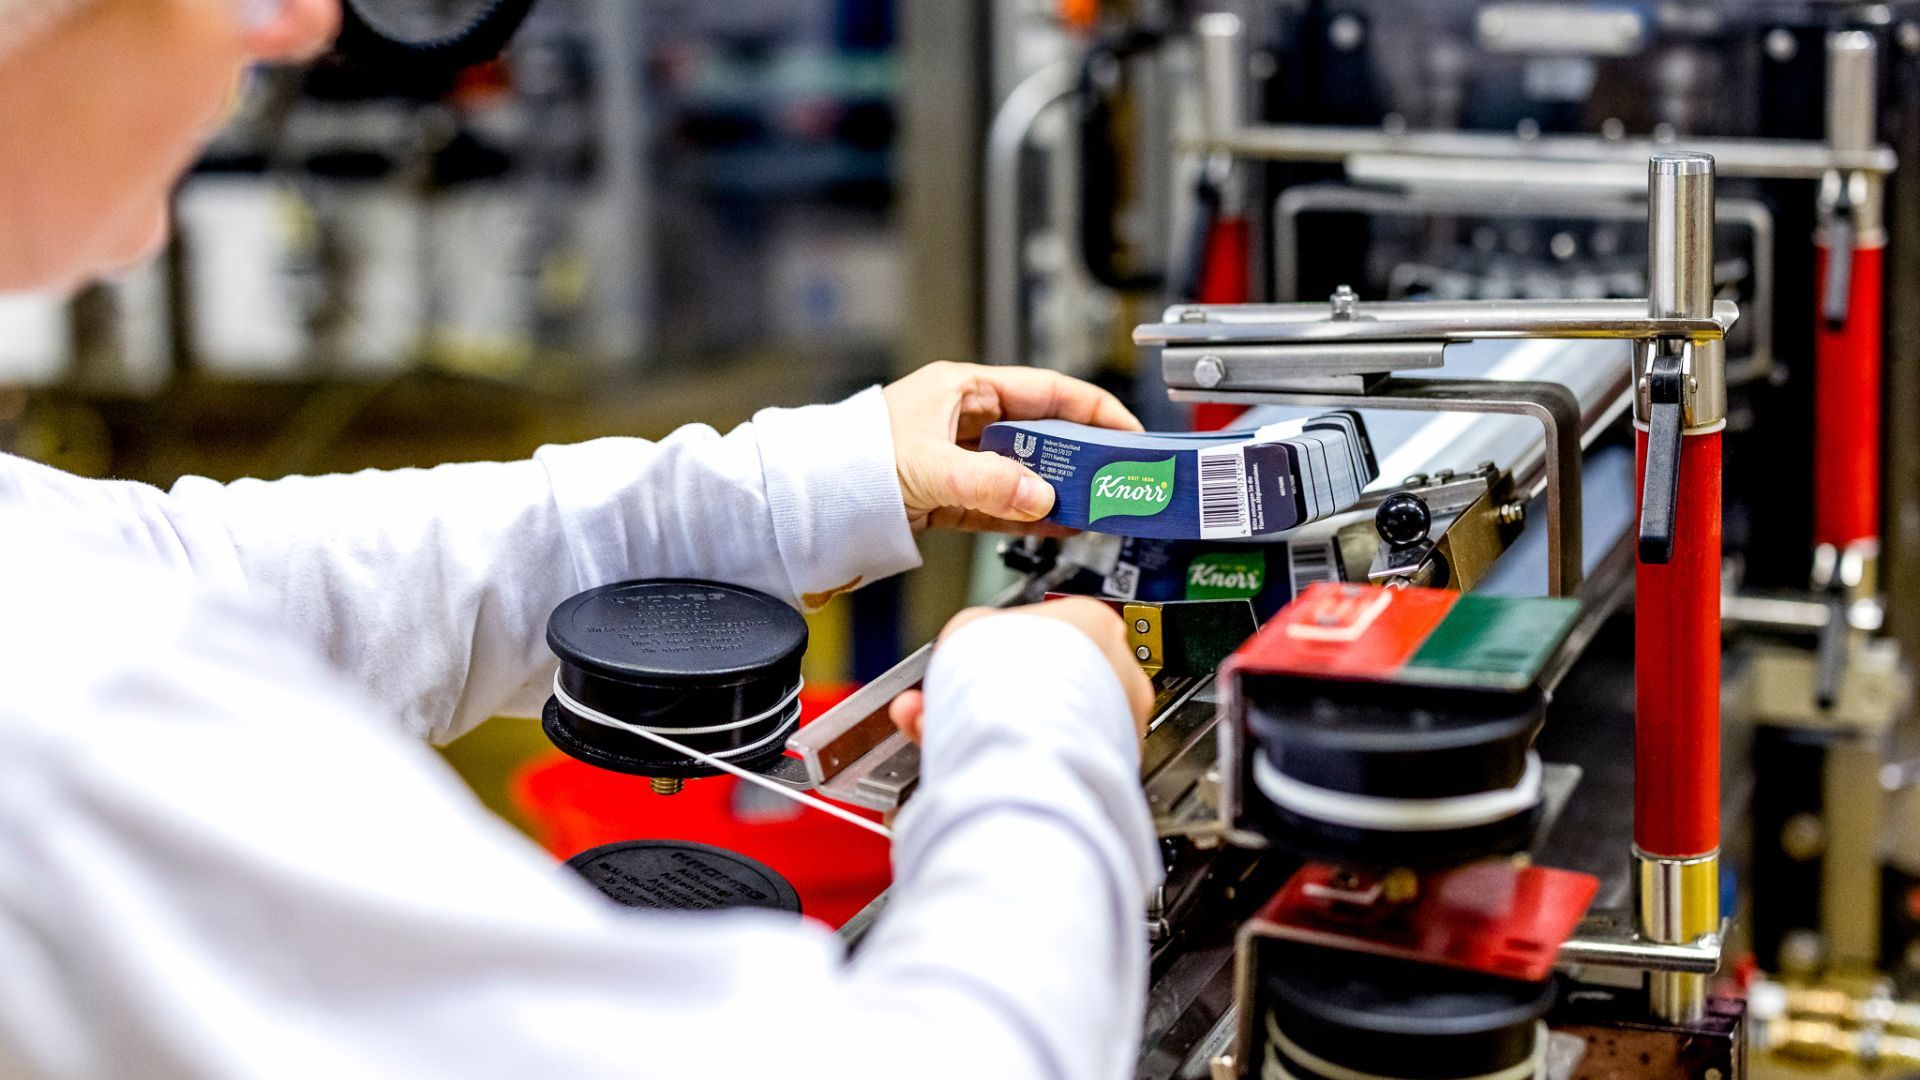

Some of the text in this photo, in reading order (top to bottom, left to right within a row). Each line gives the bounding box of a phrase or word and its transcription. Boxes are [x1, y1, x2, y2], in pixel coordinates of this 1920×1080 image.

[1042, 445, 1058, 454] Postfach
[1058, 442, 1081, 451] Deutschland
[1053, 455, 1070, 464] Hamburg
[1095, 474, 1168, 503] Knorr
[1189, 563, 1261, 590] Knorr
